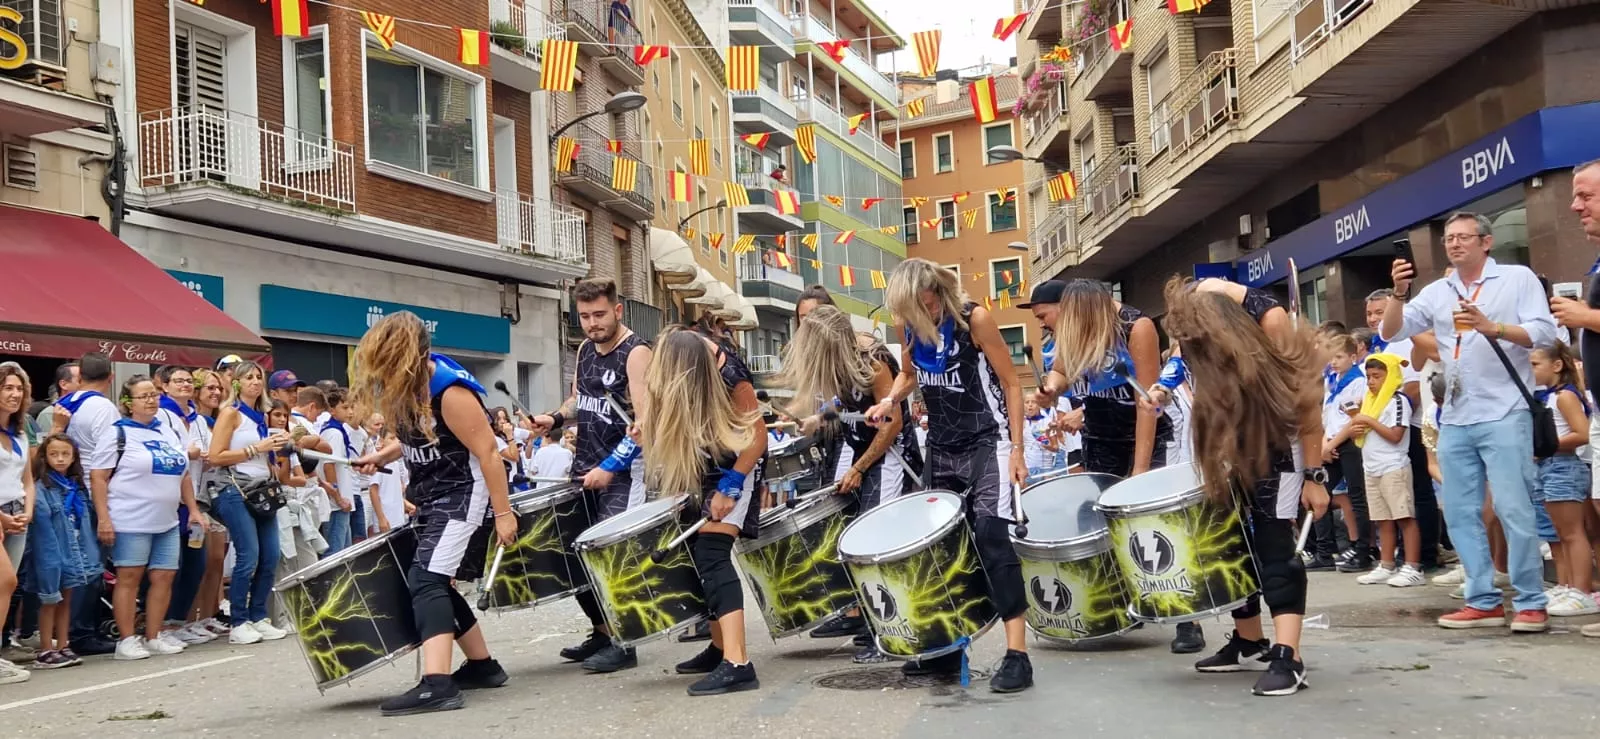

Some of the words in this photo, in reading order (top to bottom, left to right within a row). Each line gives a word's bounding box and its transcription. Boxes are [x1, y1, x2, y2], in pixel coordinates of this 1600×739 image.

[1462, 137, 1515, 188] BBVA
[1335, 205, 1371, 244] BBVA
[1248, 250, 1274, 282] BBVA
[98, 340, 117, 358] El
[122, 342, 168, 361] Cortés
[1137, 574, 1190, 592] SAMBALA
